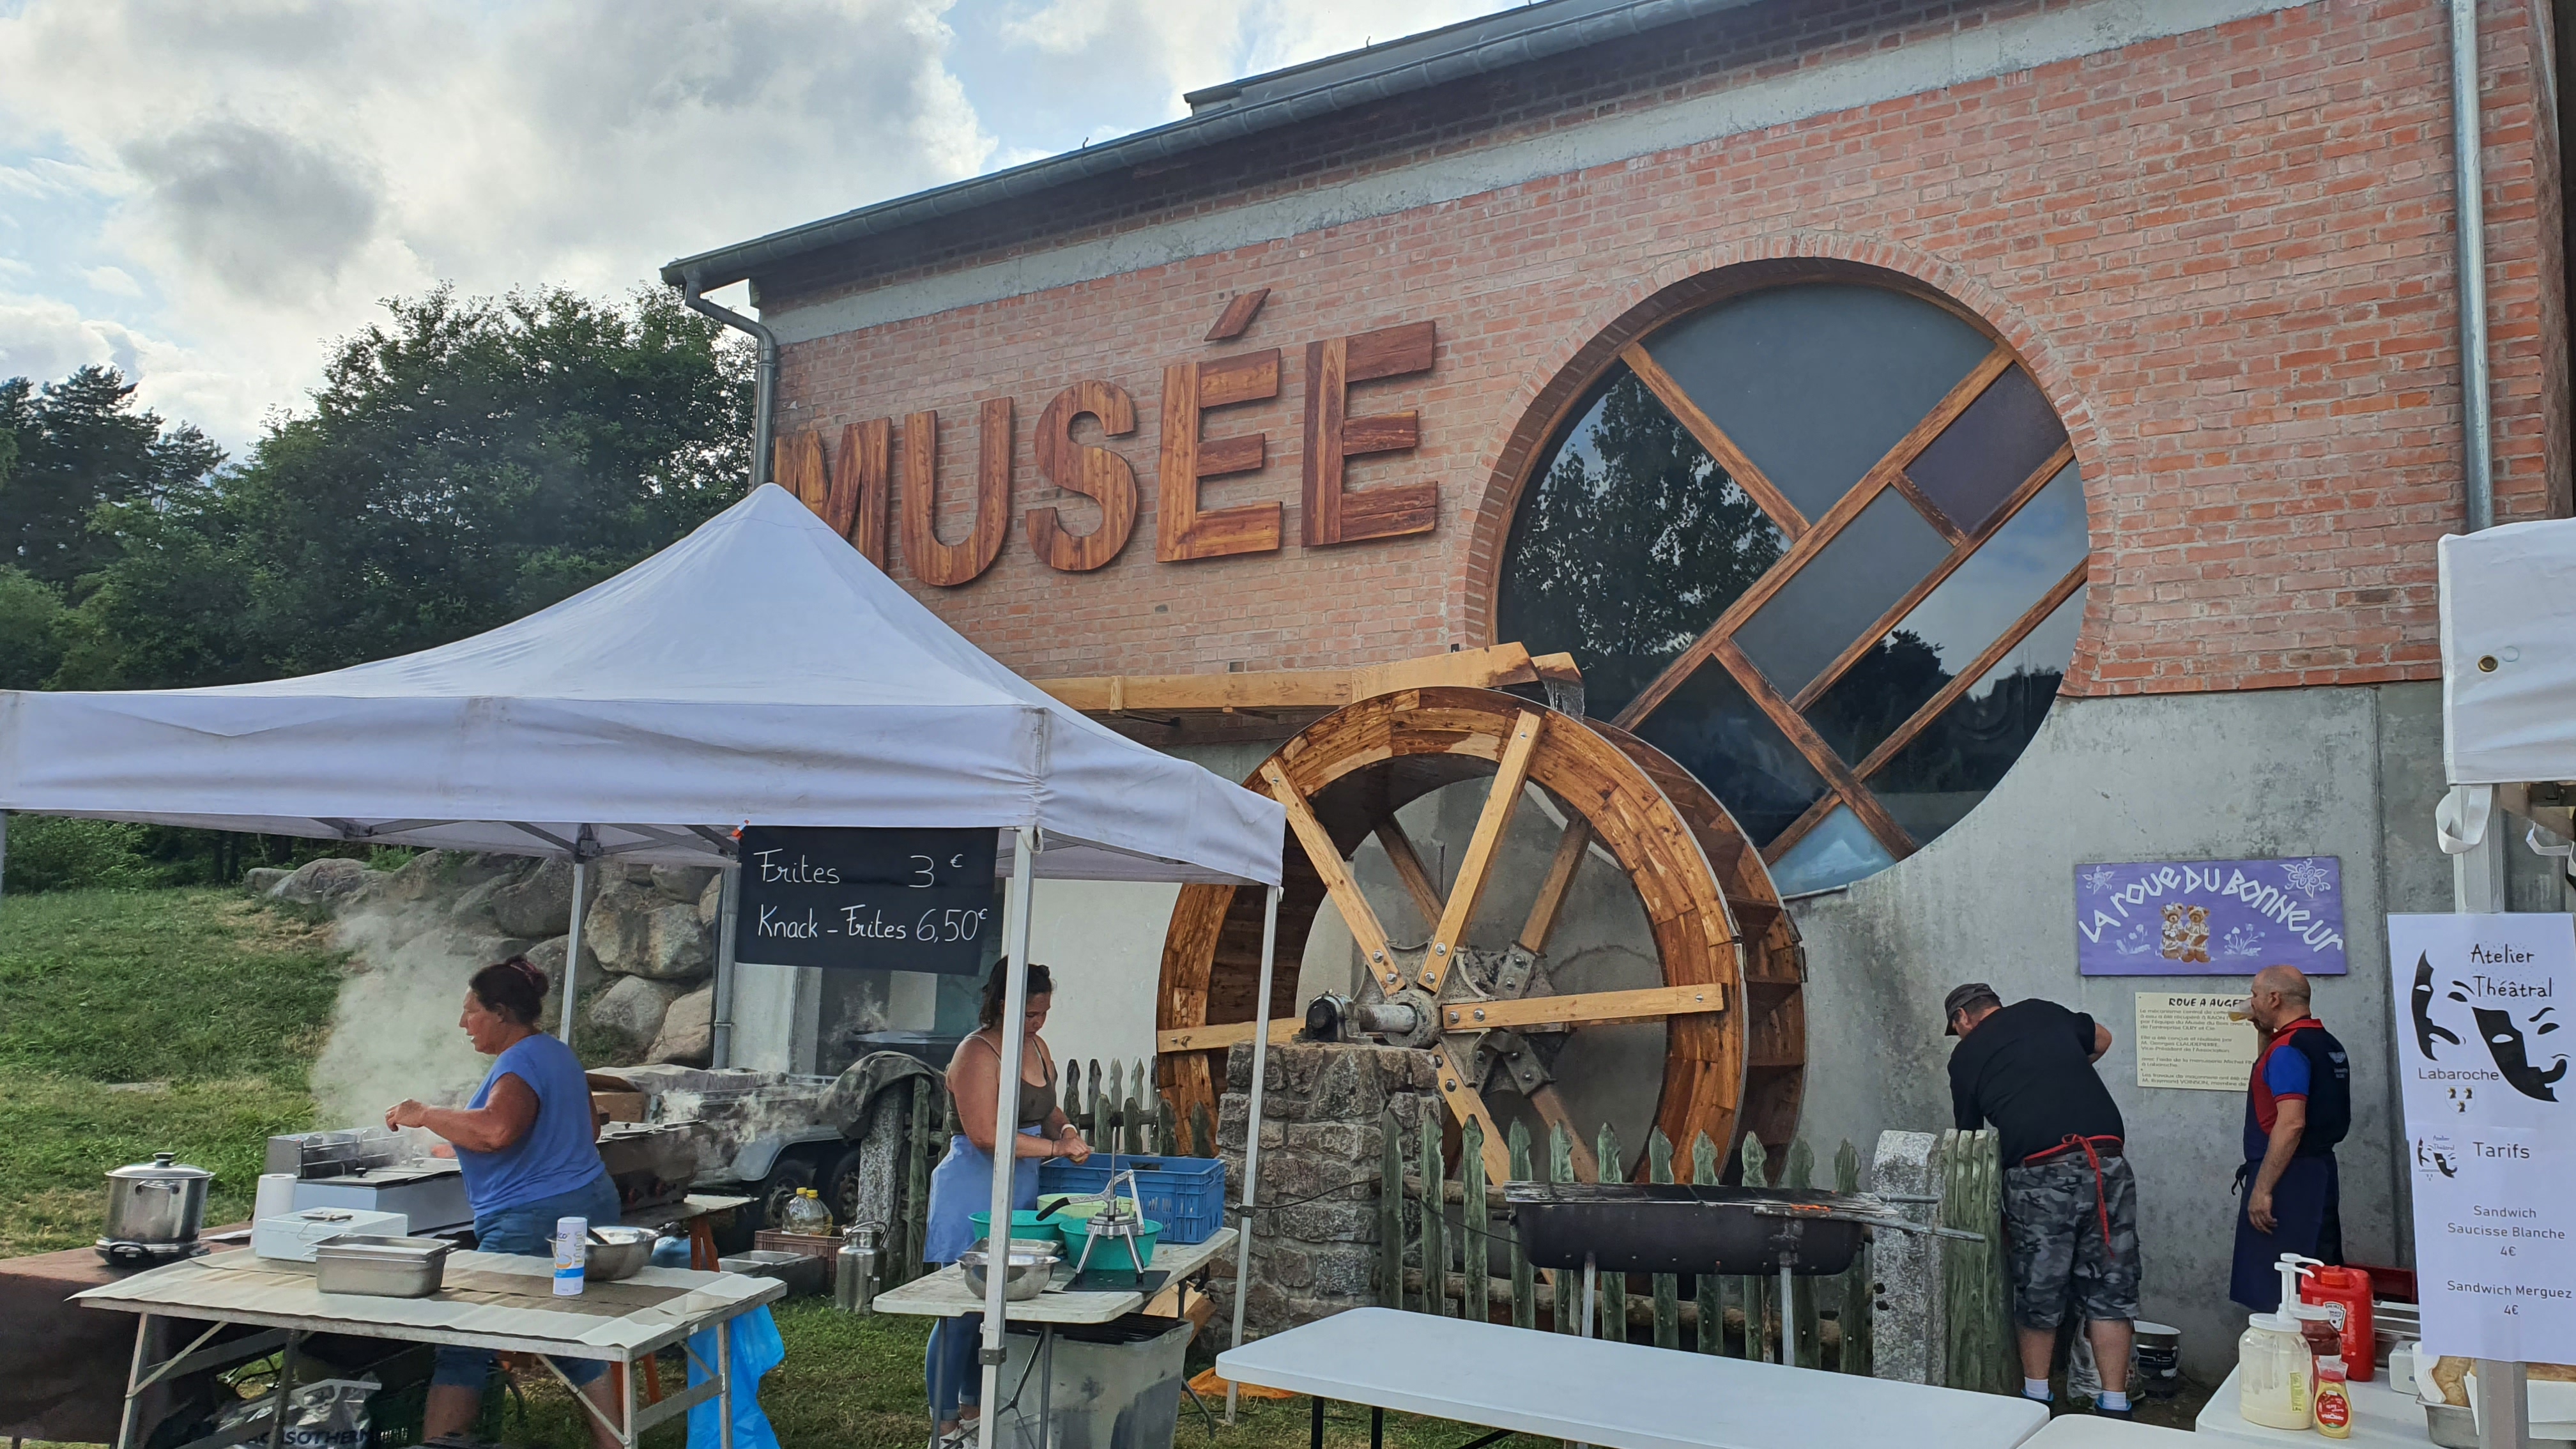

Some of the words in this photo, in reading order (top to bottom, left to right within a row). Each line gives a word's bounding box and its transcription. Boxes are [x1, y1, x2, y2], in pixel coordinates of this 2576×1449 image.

[774, 288, 1437, 586] MUSÉE
[754, 848, 840, 884] Frites
[908, 855, 934, 888] 3
[949, 854, 963, 869] €
[2078, 909, 2121, 944] LA
[2182, 866, 2220, 894] DU
[758, 904, 818, 939] Knack
[840, 904, 907, 939] Frites
[2471, 943, 2534, 964] Atelier
[2472, 976, 2552, 997] Théâtral
[2169, 998, 2197, 1007] ROUE
[2200, 999, 2206, 1007] A
[2418, 1068, 2499, 1081] Labaroche
[2472, 1142, 2530, 1159] Tarifs
[2473, 1205, 2537, 1218] Sandwich
[2448, 1223, 2508, 1237] Saucisse
[2512, 1227, 2565, 1240] Blanche
[2500, 1246, 2517, 1257] 4€
[2447, 1280, 2512, 1296] Sandwich
[2516, 1285, 2573, 1300] Merguez
[2504, 1305, 2518, 1315] 4€
